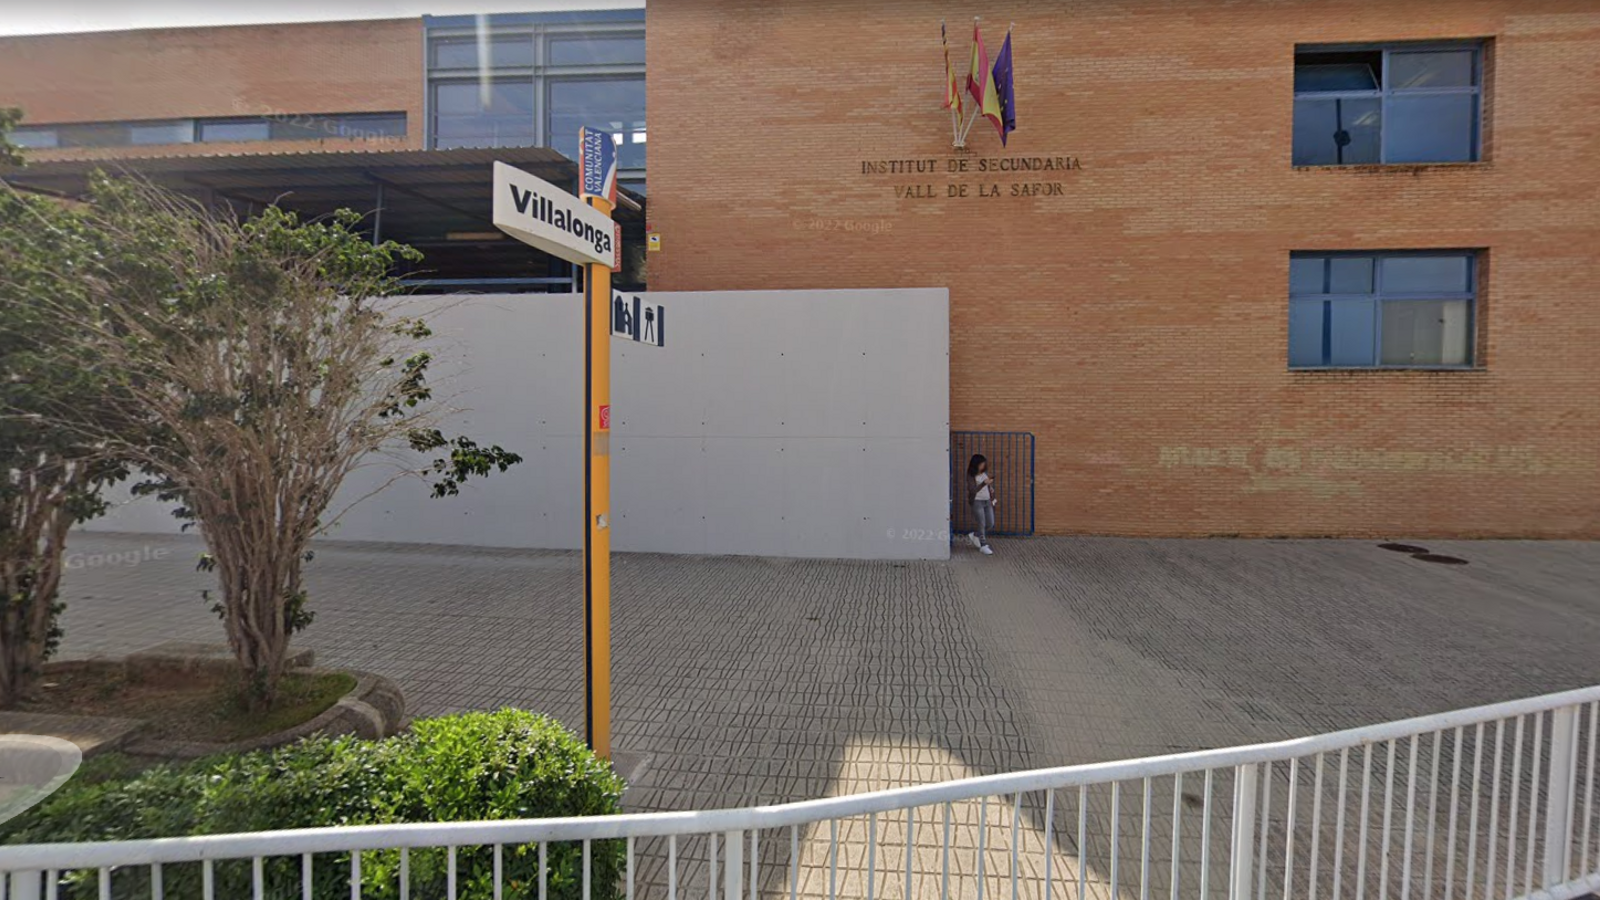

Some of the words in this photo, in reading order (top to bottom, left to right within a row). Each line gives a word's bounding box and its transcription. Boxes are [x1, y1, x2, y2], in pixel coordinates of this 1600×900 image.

[584, 128, 594, 191] COMUNITAT
[593, 132, 603, 193] VALENCIANA
[861, 159, 937, 174] INSTITUT
[947, 158, 969, 173] DE
[978, 156, 1083, 172] SECUNDARIA
[894, 184, 937, 198] VALL
[947, 183, 969, 198] DE
[979, 183, 1001, 198] LA
[1010, 182, 1064, 197] SAFOR
[508, 183, 612, 253] Villalonga
